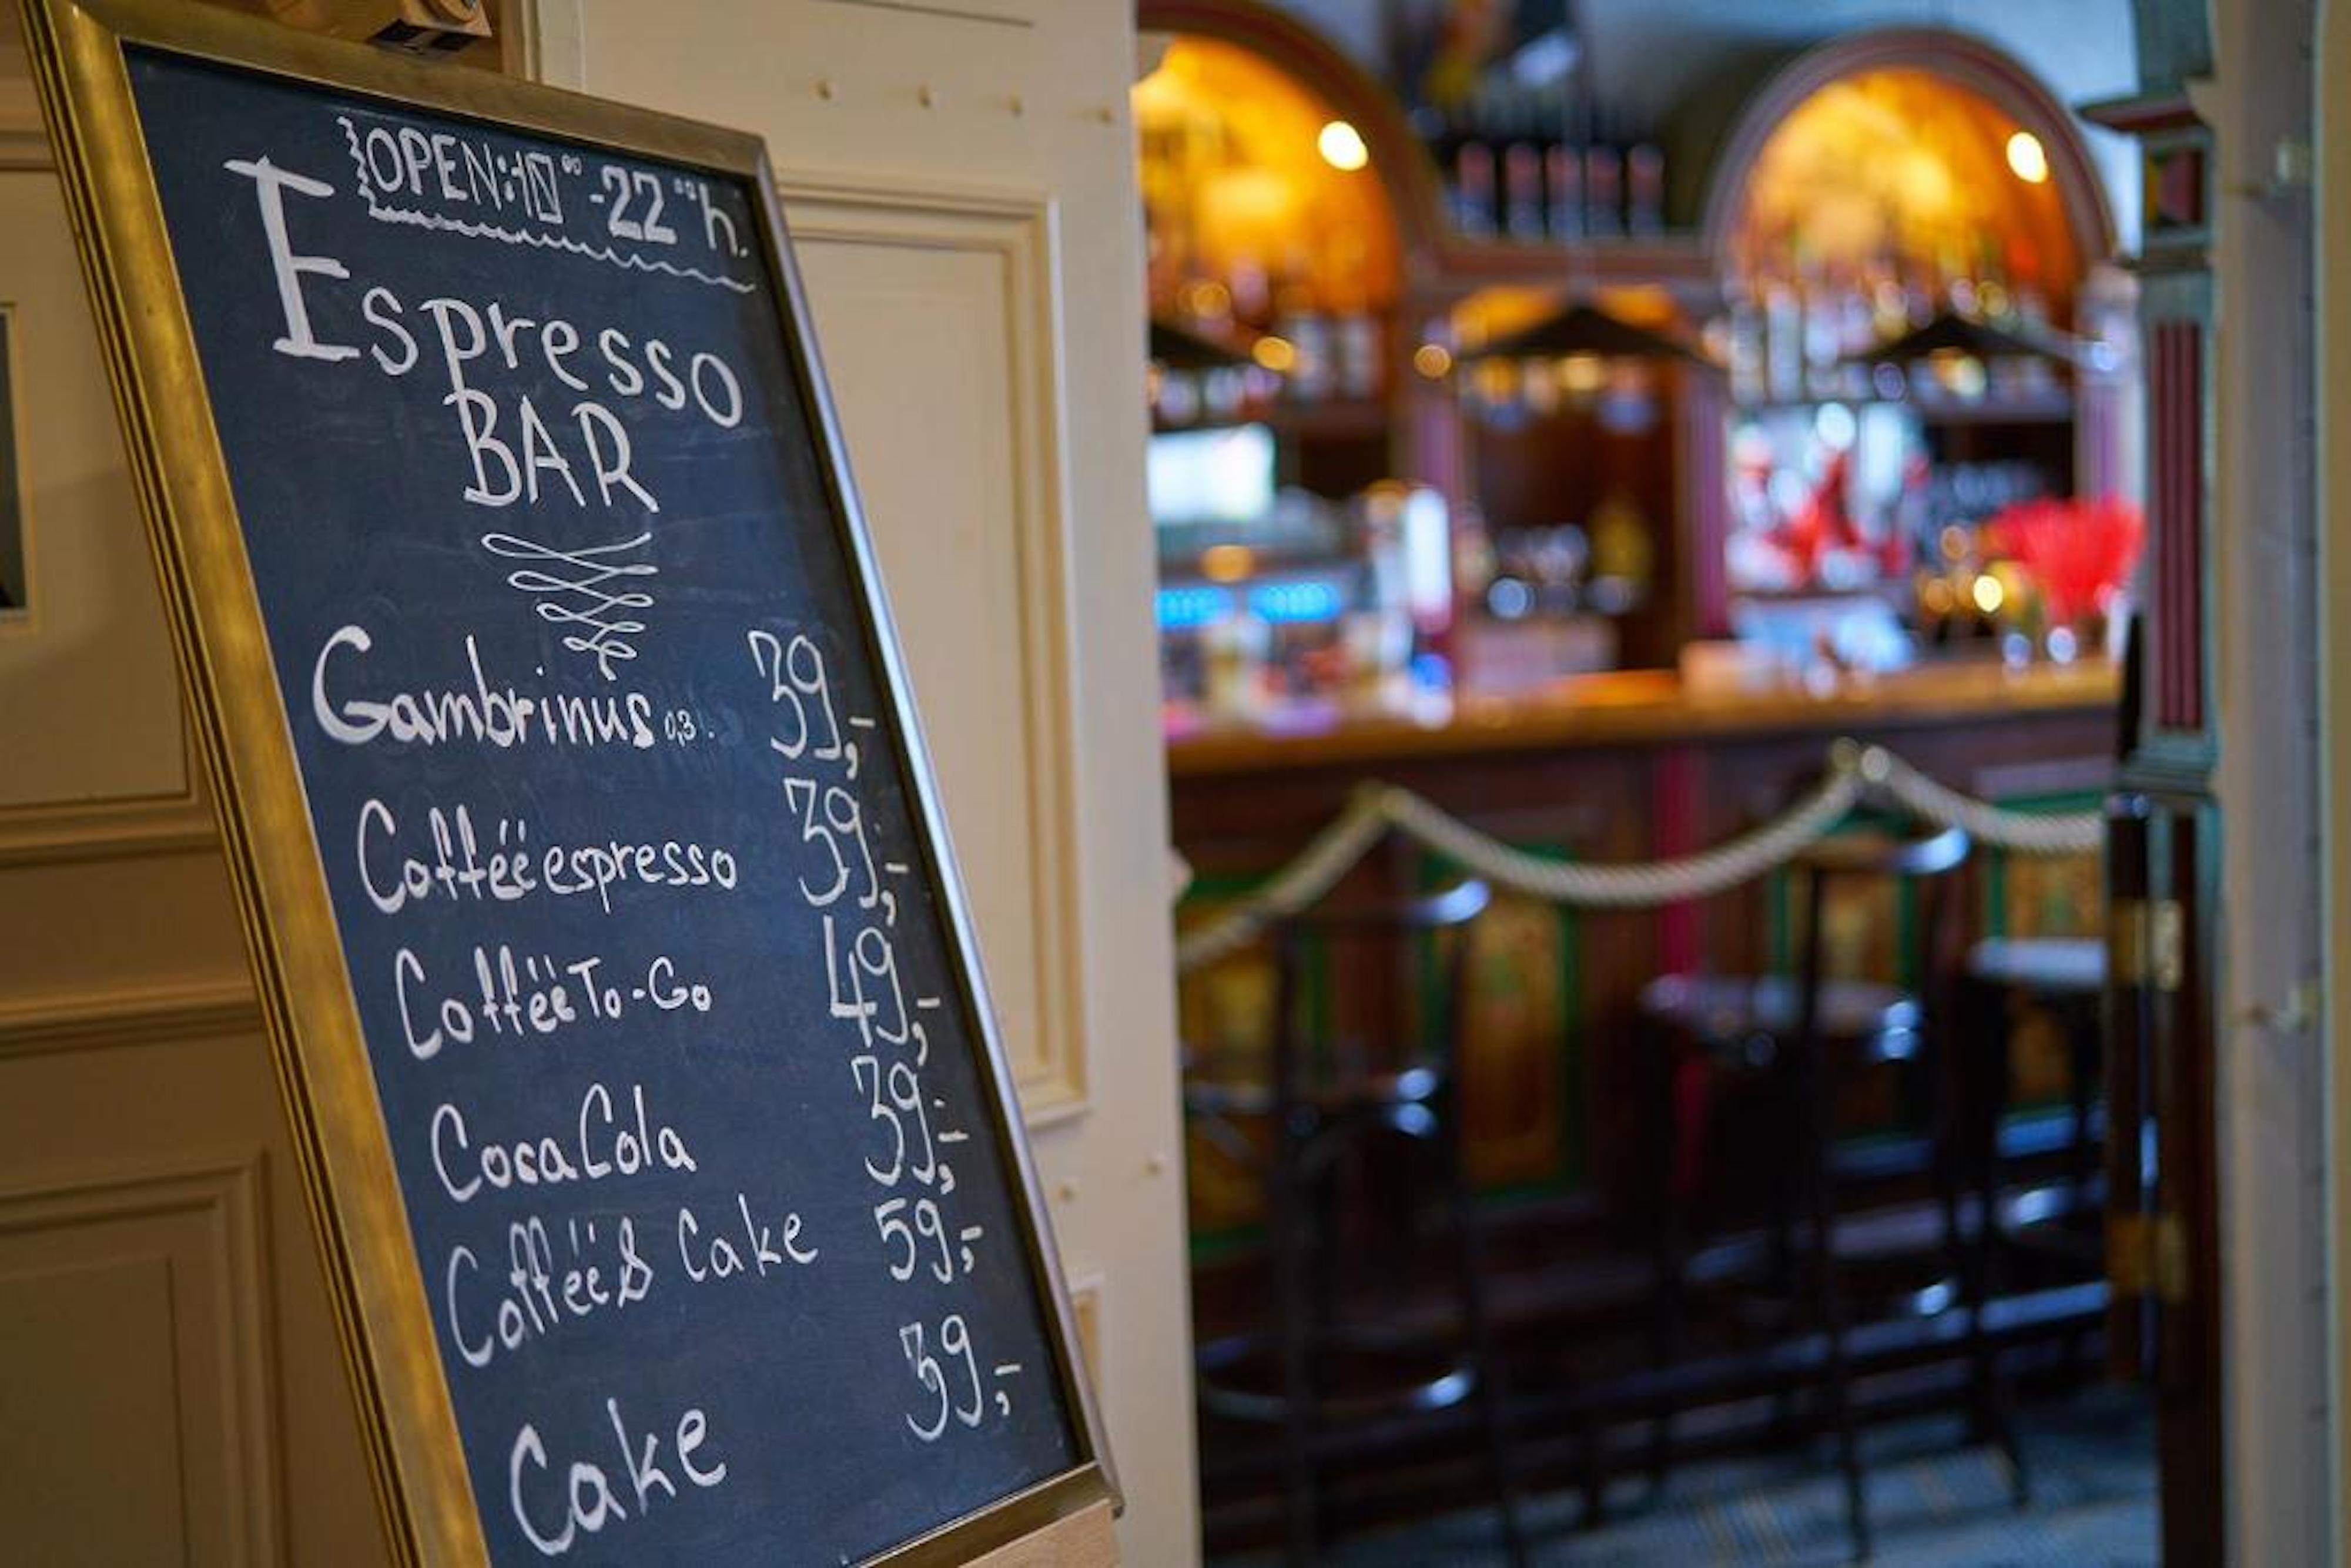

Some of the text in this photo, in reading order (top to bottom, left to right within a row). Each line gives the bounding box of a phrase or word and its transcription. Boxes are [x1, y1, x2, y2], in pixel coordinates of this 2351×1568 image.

[223, 155, 742, 428] Espresso
[442, 389, 659, 514] BAR
[313, 625, 656, 750] Gambrinus
[677, 1192, 819, 1282] Cake
[510, 1397, 727, 1556] Cake
